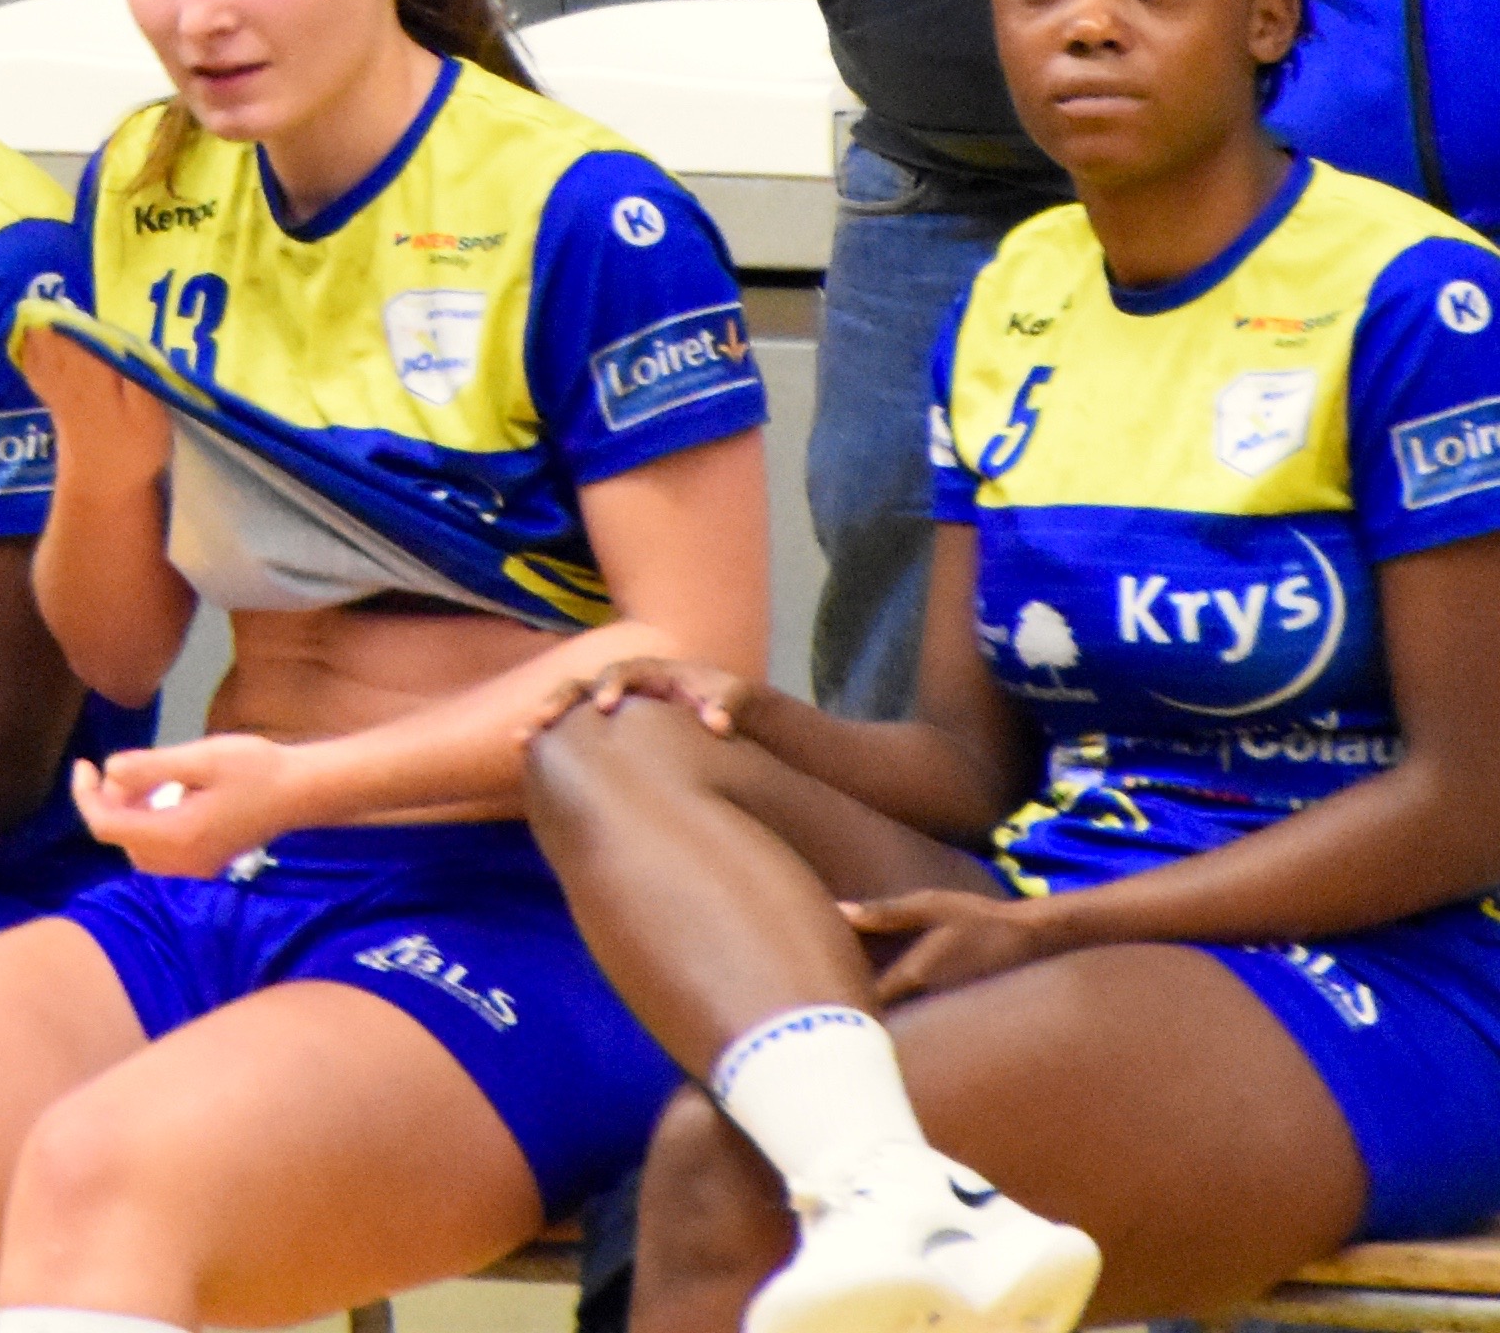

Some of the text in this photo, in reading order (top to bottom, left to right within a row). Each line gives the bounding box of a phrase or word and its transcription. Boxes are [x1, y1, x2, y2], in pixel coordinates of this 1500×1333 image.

[148, 268, 229, 384] 13
[604, 329, 722, 397] Loiret
[976, 366, 1057, 481] 5
[1408, 420, 1500, 475] Loir
[1116, 573, 1321, 663] Krys
